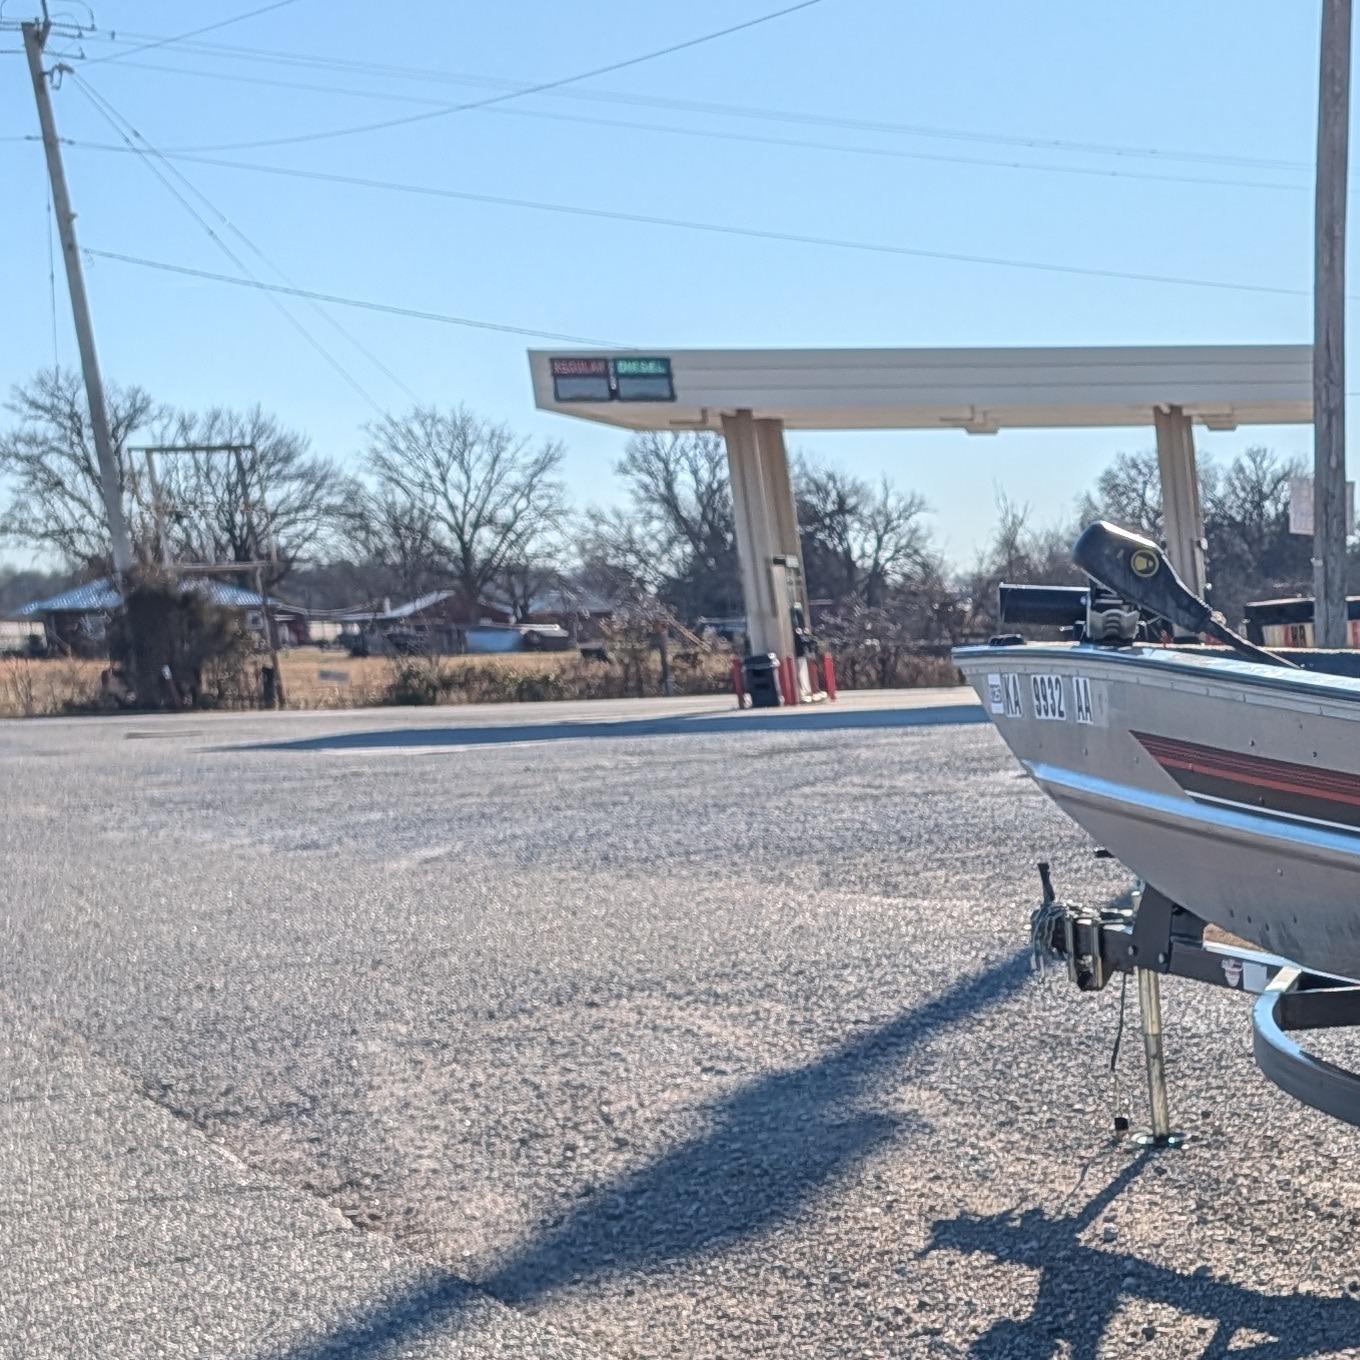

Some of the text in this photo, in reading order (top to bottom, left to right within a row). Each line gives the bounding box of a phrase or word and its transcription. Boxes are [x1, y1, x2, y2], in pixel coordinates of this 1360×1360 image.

[616, 359, 667, 374] DIESEL
[1004, 673, 1022, 716] KA
[1033, 676, 1065, 719] 9932
[1075, 678, 1093, 722] AA
